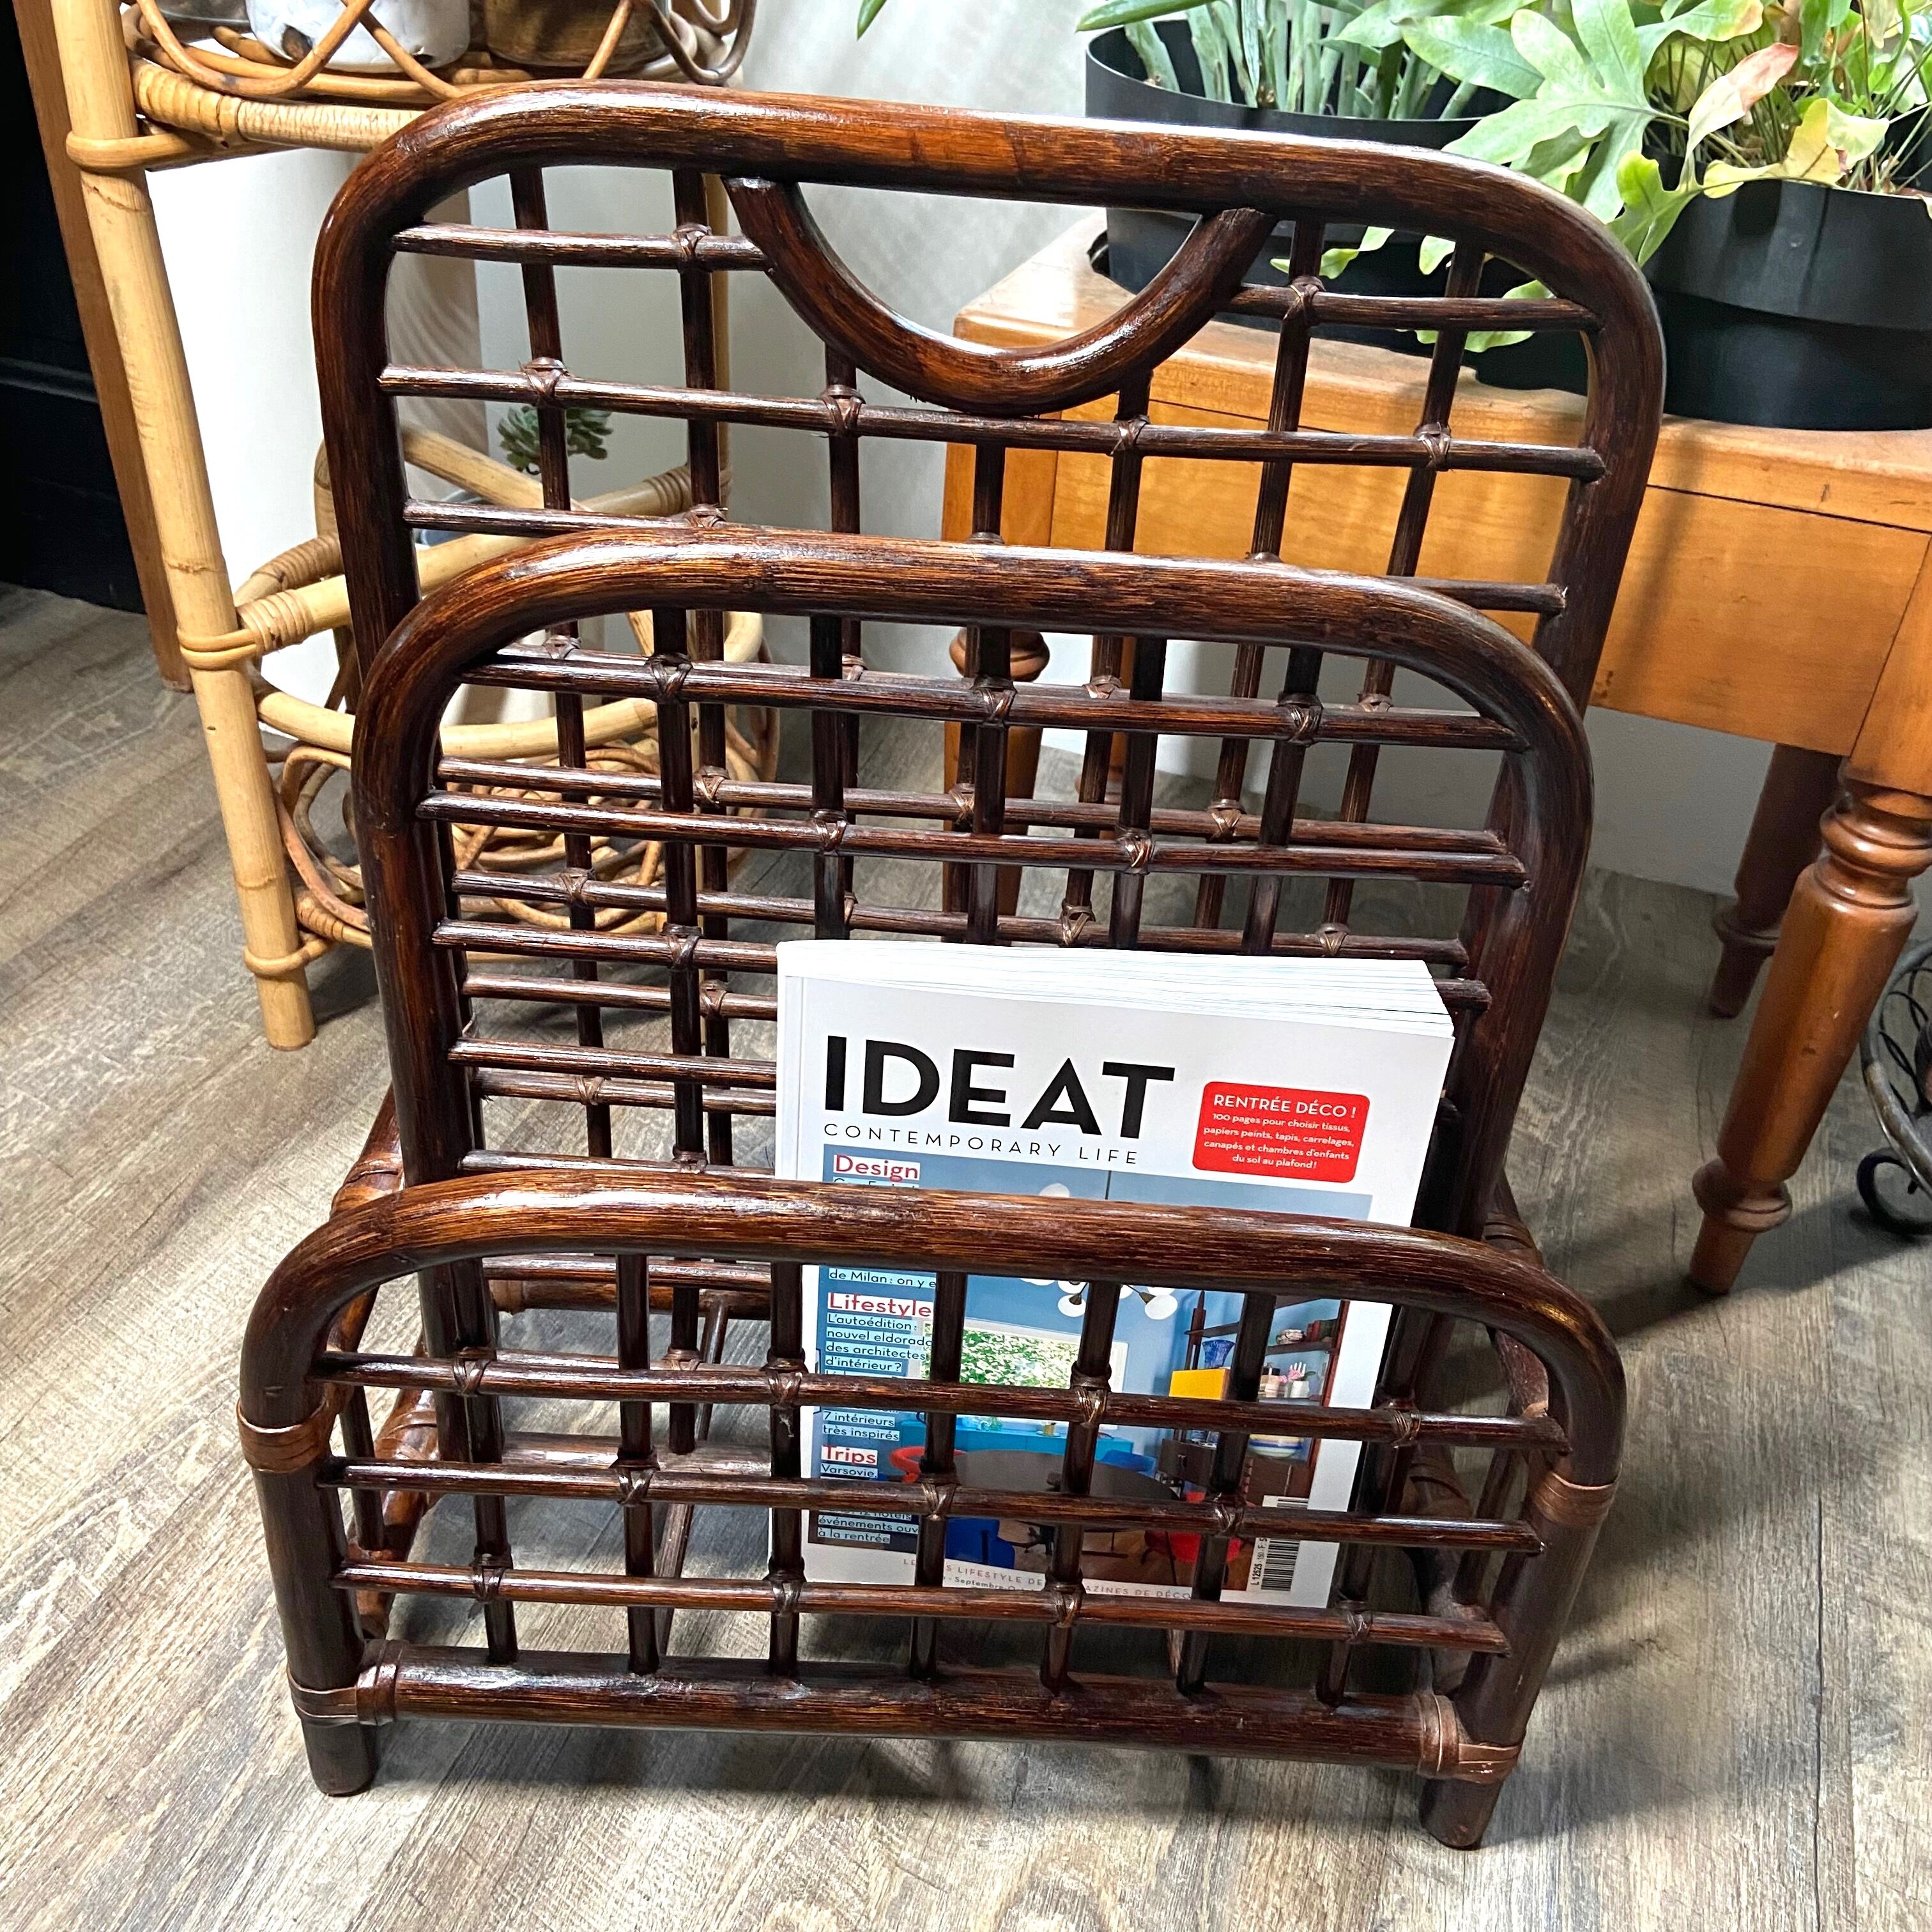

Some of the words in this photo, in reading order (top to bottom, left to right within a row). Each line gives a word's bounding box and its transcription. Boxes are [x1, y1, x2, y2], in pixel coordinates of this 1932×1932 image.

[824, 1035, 1175, 1138] IDEAT
[1214, 1094, 1291, 1113] RENTRÉE
[1296, 1099, 1347, 1117] DÉCO
[1232, 1116, 1261, 1125] pages
[1262, 1119, 1285, 1128] pour
[1288, 1119, 1319, 1129] choisir
[1322, 1122, 1351, 1133] tissus,
[824, 1123, 1061, 1157] CONTEMPORARY
[1079, 1147, 1137, 1164] LIFE
[1204, 1126, 1239, 1137] papiers
[1241, 1128, 1273, 1140] peints,
[1275, 1132, 1301, 1142] tapis,
[1303, 1135, 1355, 1147] carrelages,
[1204, 1140, 1243, 1151] canapés
[1257, 1145, 1304, 1156] chambres
[1306, 1149, 1350, 1160] d'enfants
[1232, 1154, 1245, 1163] du
[1246, 1156, 1261, 1164] sol
[836, 1154, 918, 1182] Design
[830, 1269, 847, 1280] de
[830, 1292, 931, 1317] Lifestyle
[827, 1331, 870, 1340] nouvel
[826, 1342, 848, 1353] des
[854, 1347, 926, 1360] architectes
[824, 1411, 831, 1420] 7
[834, 1413, 894, 1426] intérieurs
[823, 1425, 847, 1436] très
[850, 1427, 899, 1441] inspirés
[823, 1445, 877, 1465] Trips
[818, 1516, 893, 1531] événements
[818, 1528, 825, 1537] à
[830, 1528, 840, 1538] la
[845, 1533, 890, 1543] rentrée
[958, 1567, 1022, 1583] LIFESTYLE
[1085, 1585, 1128, 1595] AZINES
